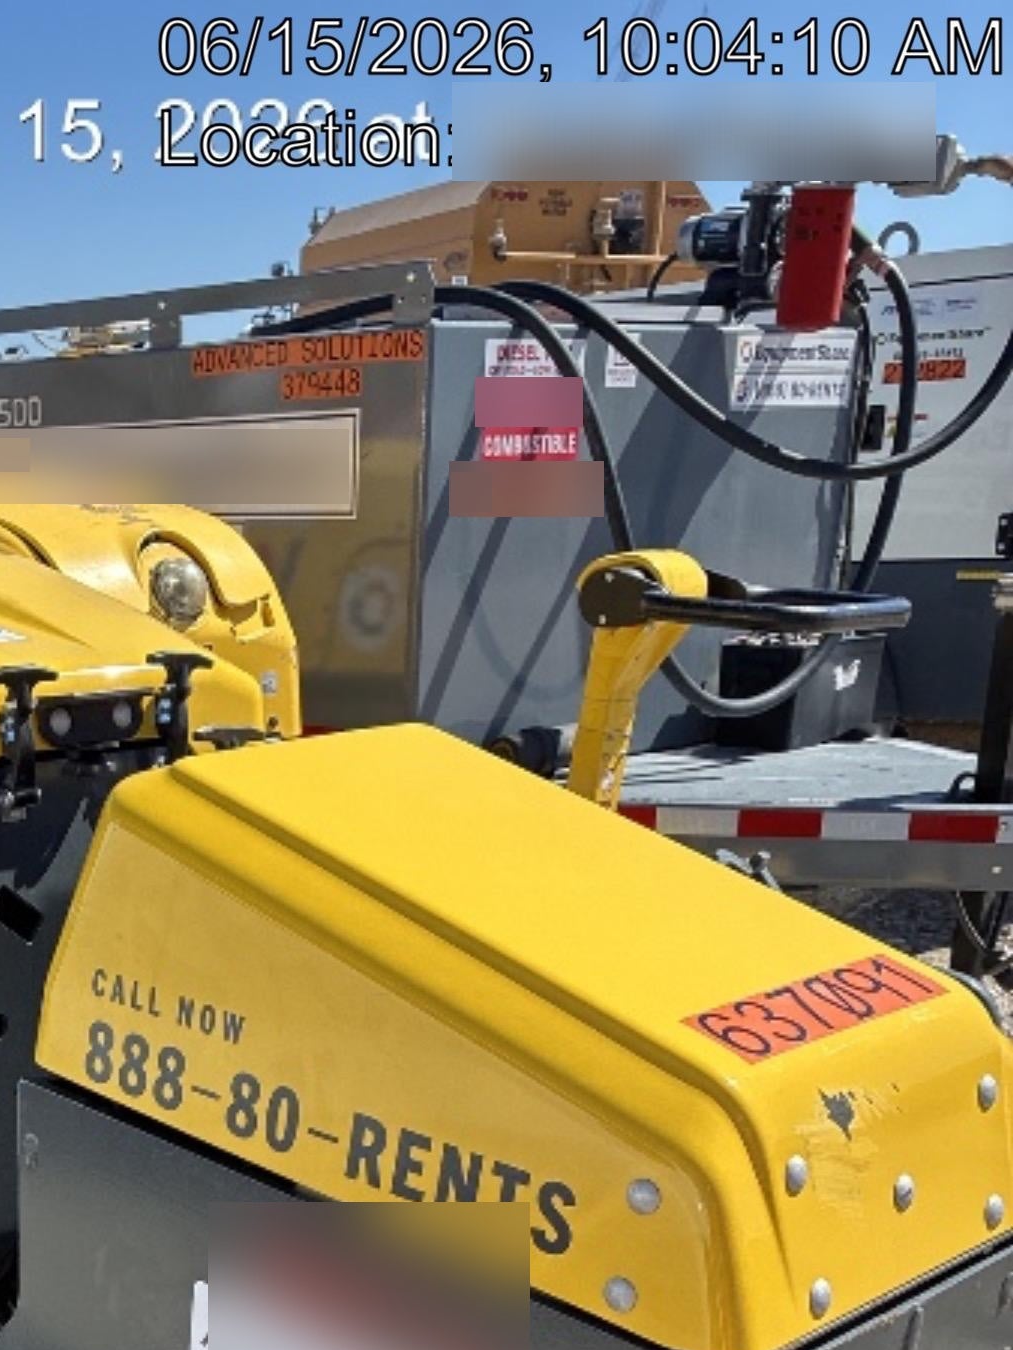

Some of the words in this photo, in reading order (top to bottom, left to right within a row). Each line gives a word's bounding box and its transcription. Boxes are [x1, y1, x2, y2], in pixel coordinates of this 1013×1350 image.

[192, 338, 288, 373] ADVANCED
[300, 328, 424, 364] SOLUTIONS
[281, 366, 361, 399] 379448
[482, 431, 578, 458] COMBUSTIBLE
[90, 967, 163, 1019] CALL
[176, 995, 248, 1047] NOW
[694, 958, 936, 1059] 637091
